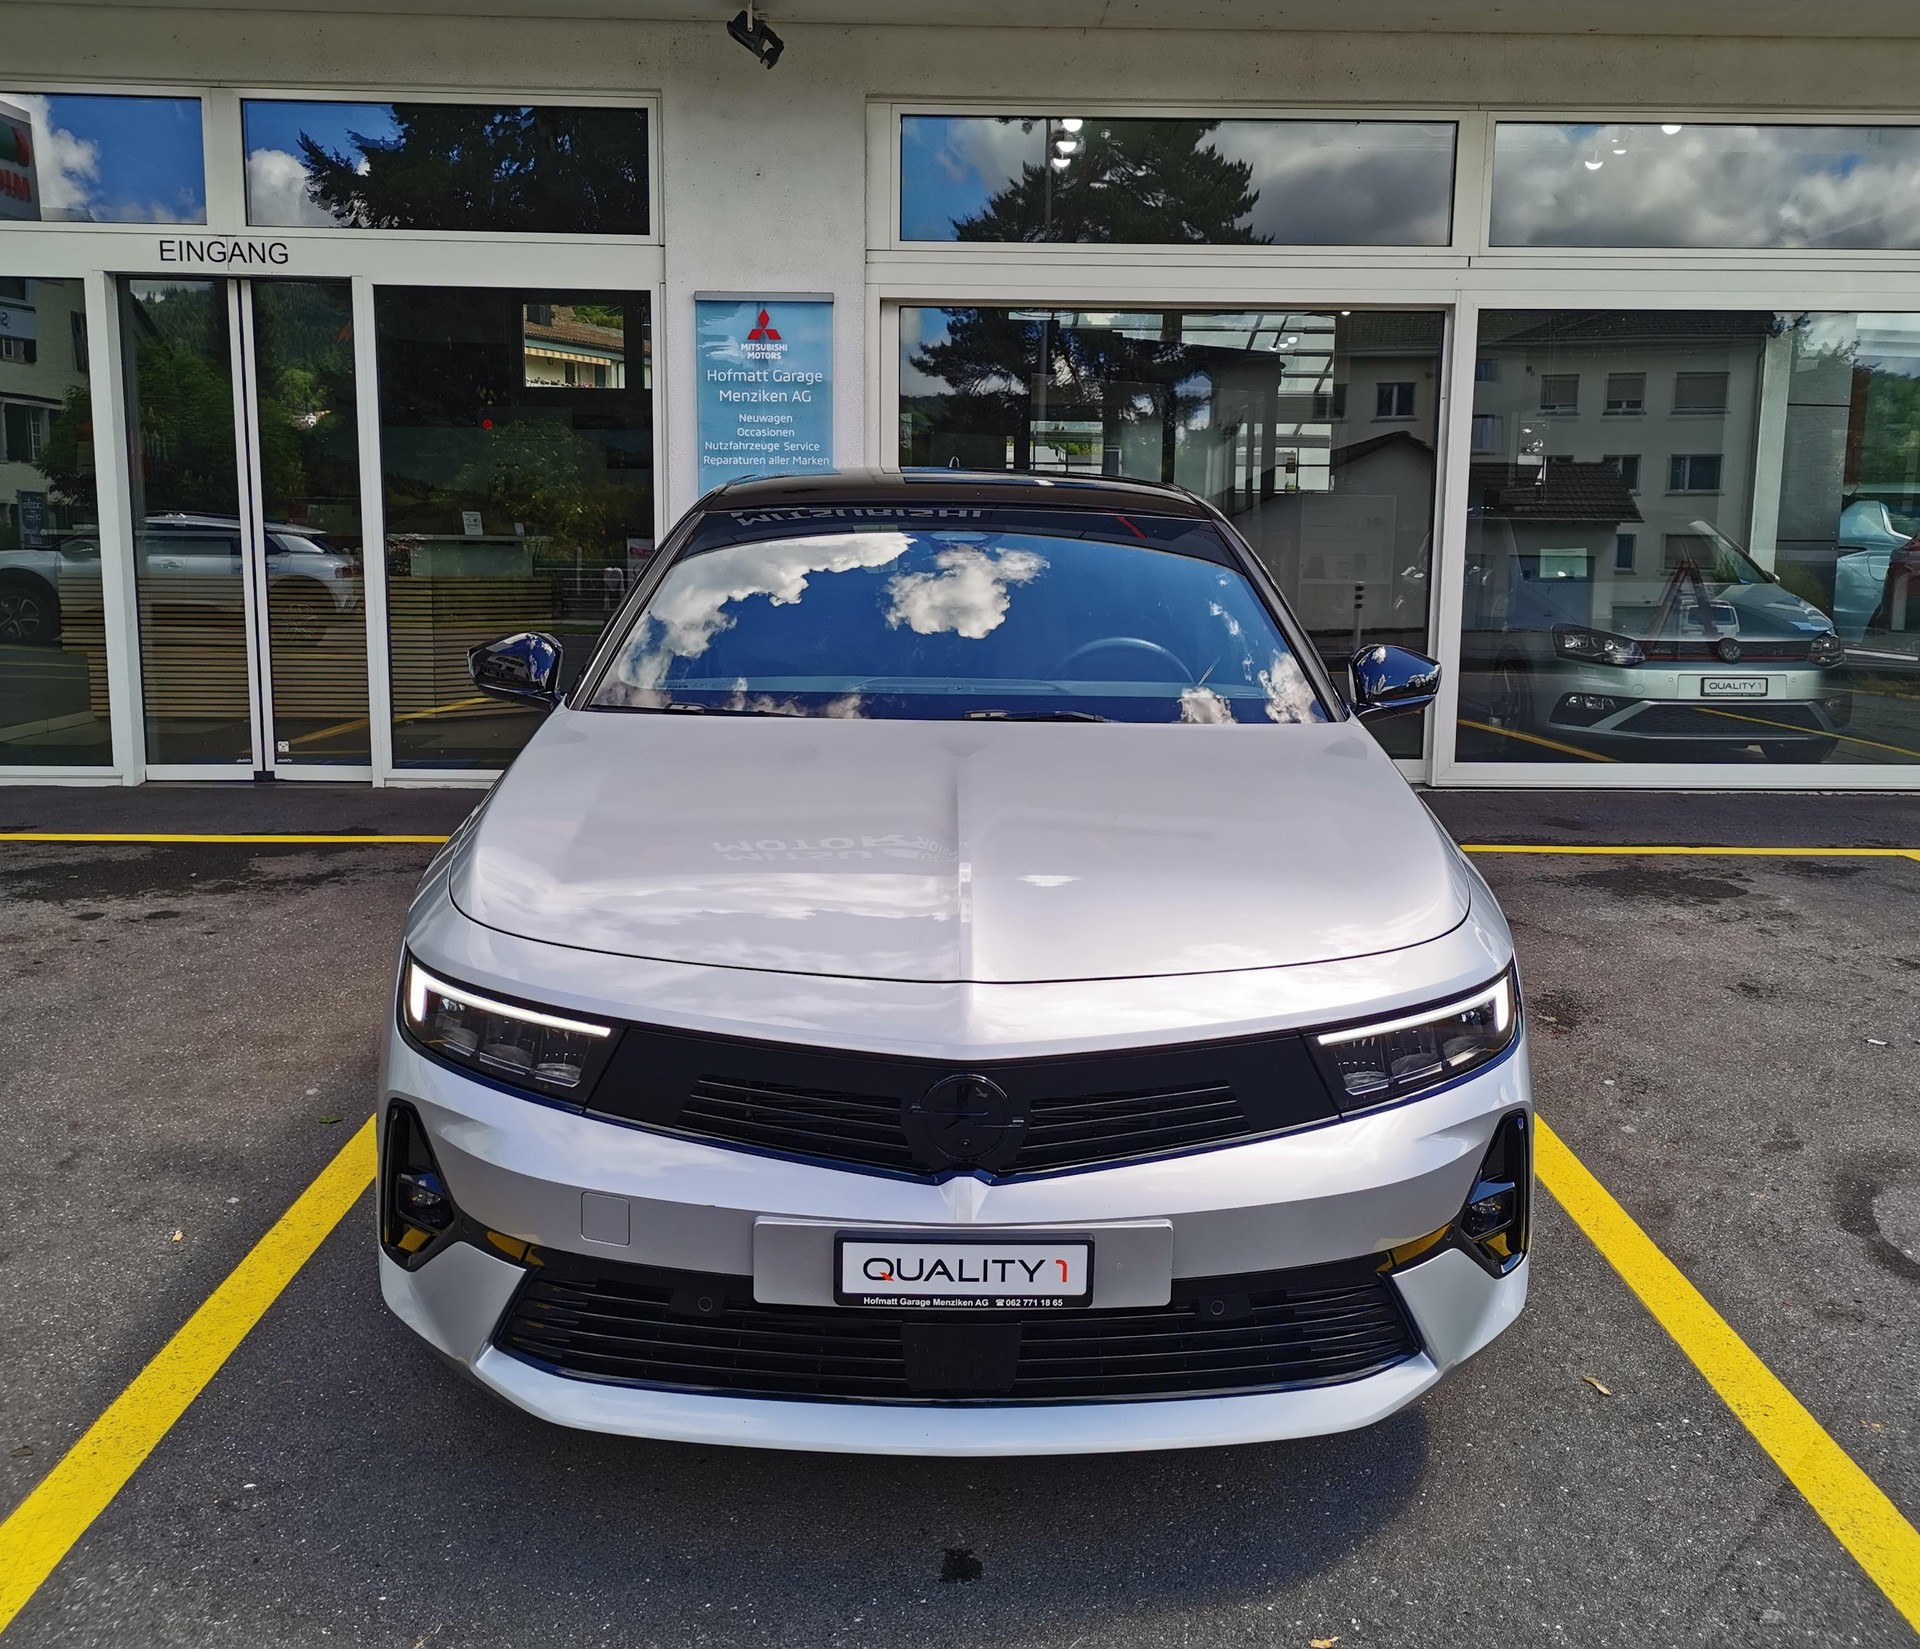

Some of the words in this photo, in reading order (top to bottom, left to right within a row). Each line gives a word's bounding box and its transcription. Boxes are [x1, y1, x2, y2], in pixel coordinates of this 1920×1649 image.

[159, 240, 289, 264] EINGANG
[741, 343, 788, 351] MITSUBISHI
[707, 369, 768, 382] Hofmatt
[772, 369, 823, 385] Garage
[719, 390, 788, 402] Menziken
[791, 390, 812, 402] AG
[738, 413, 793, 425] Neuwagen
[737, 427, 795, 437] Occasionen
[704, 441, 780, 452] Nutzfahrzeuge
[783, 442, 820, 451] Service
[703, 455, 766, 467] Reparaturen
[768, 455, 790, 465] aller
[792, 456, 830, 465] Marken
[1708, 682, 1756, 690] QUALITY
[863, 1257, 1046, 1283] QUALITY
[1055, 1258, 1068, 1283] 1
[863, 1297, 898, 1305] Hofmatt
[899, 1297, 931, 1307] Garage
[933, 1298, 973, 1307] Menziken
[975, 1298, 989, 1307] AG
[1005, 1299, 1021, 1307] 062
[1023, 1299, 1038, 1307] 771
[1040, 1299, 1050, 1307] 18
[1052, 1299, 1063, 1307] 65
